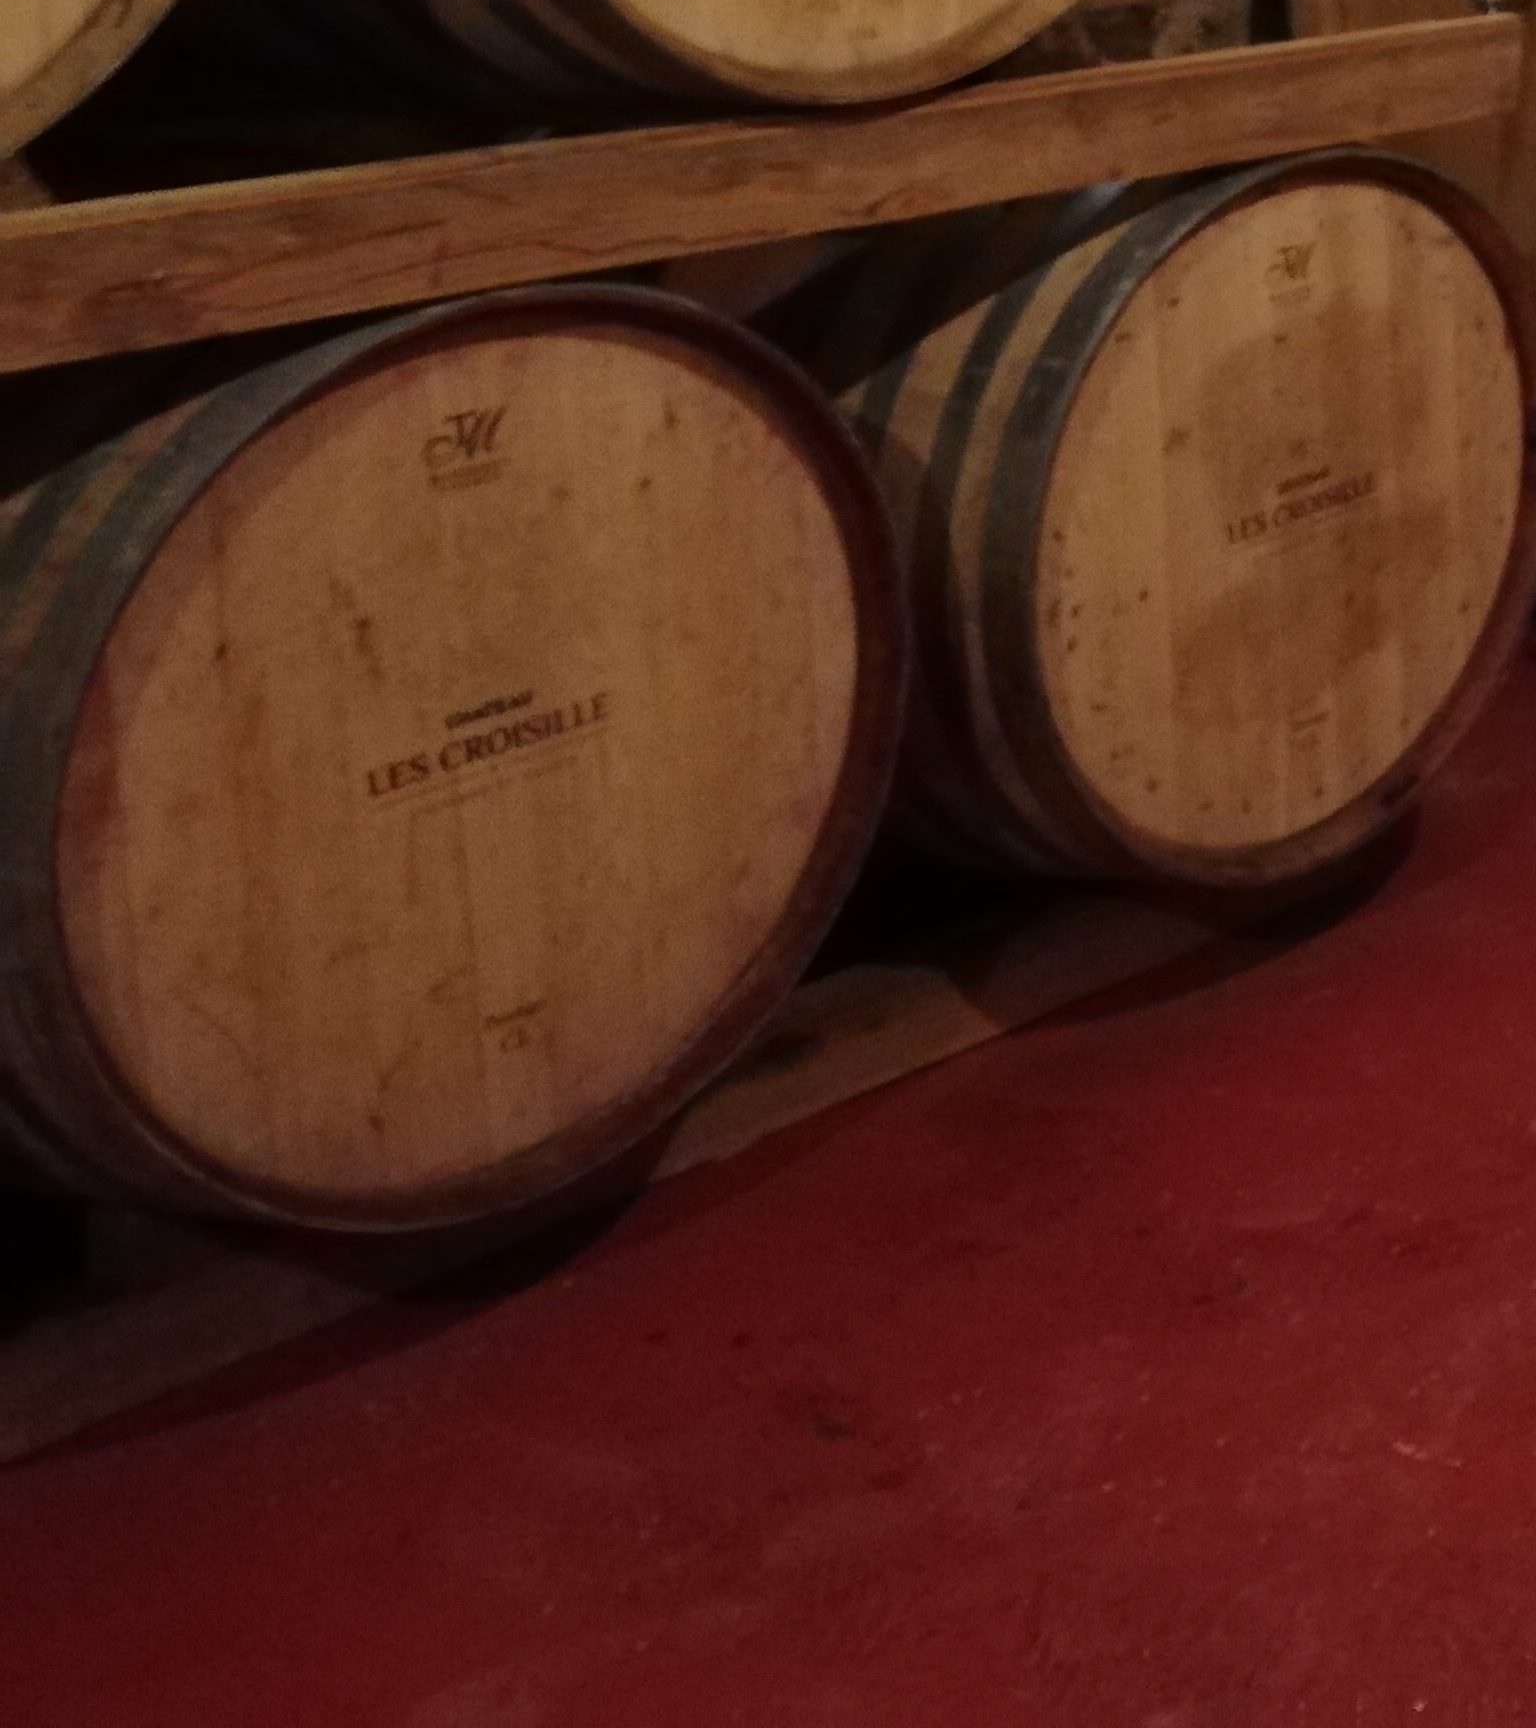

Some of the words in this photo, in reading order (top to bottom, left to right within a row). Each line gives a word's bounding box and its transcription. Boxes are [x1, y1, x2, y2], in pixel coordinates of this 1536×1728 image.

[1226, 510, 1268, 544] LES
[367, 752, 430, 797] LES
[438, 690, 609, 772] CROISILLE
